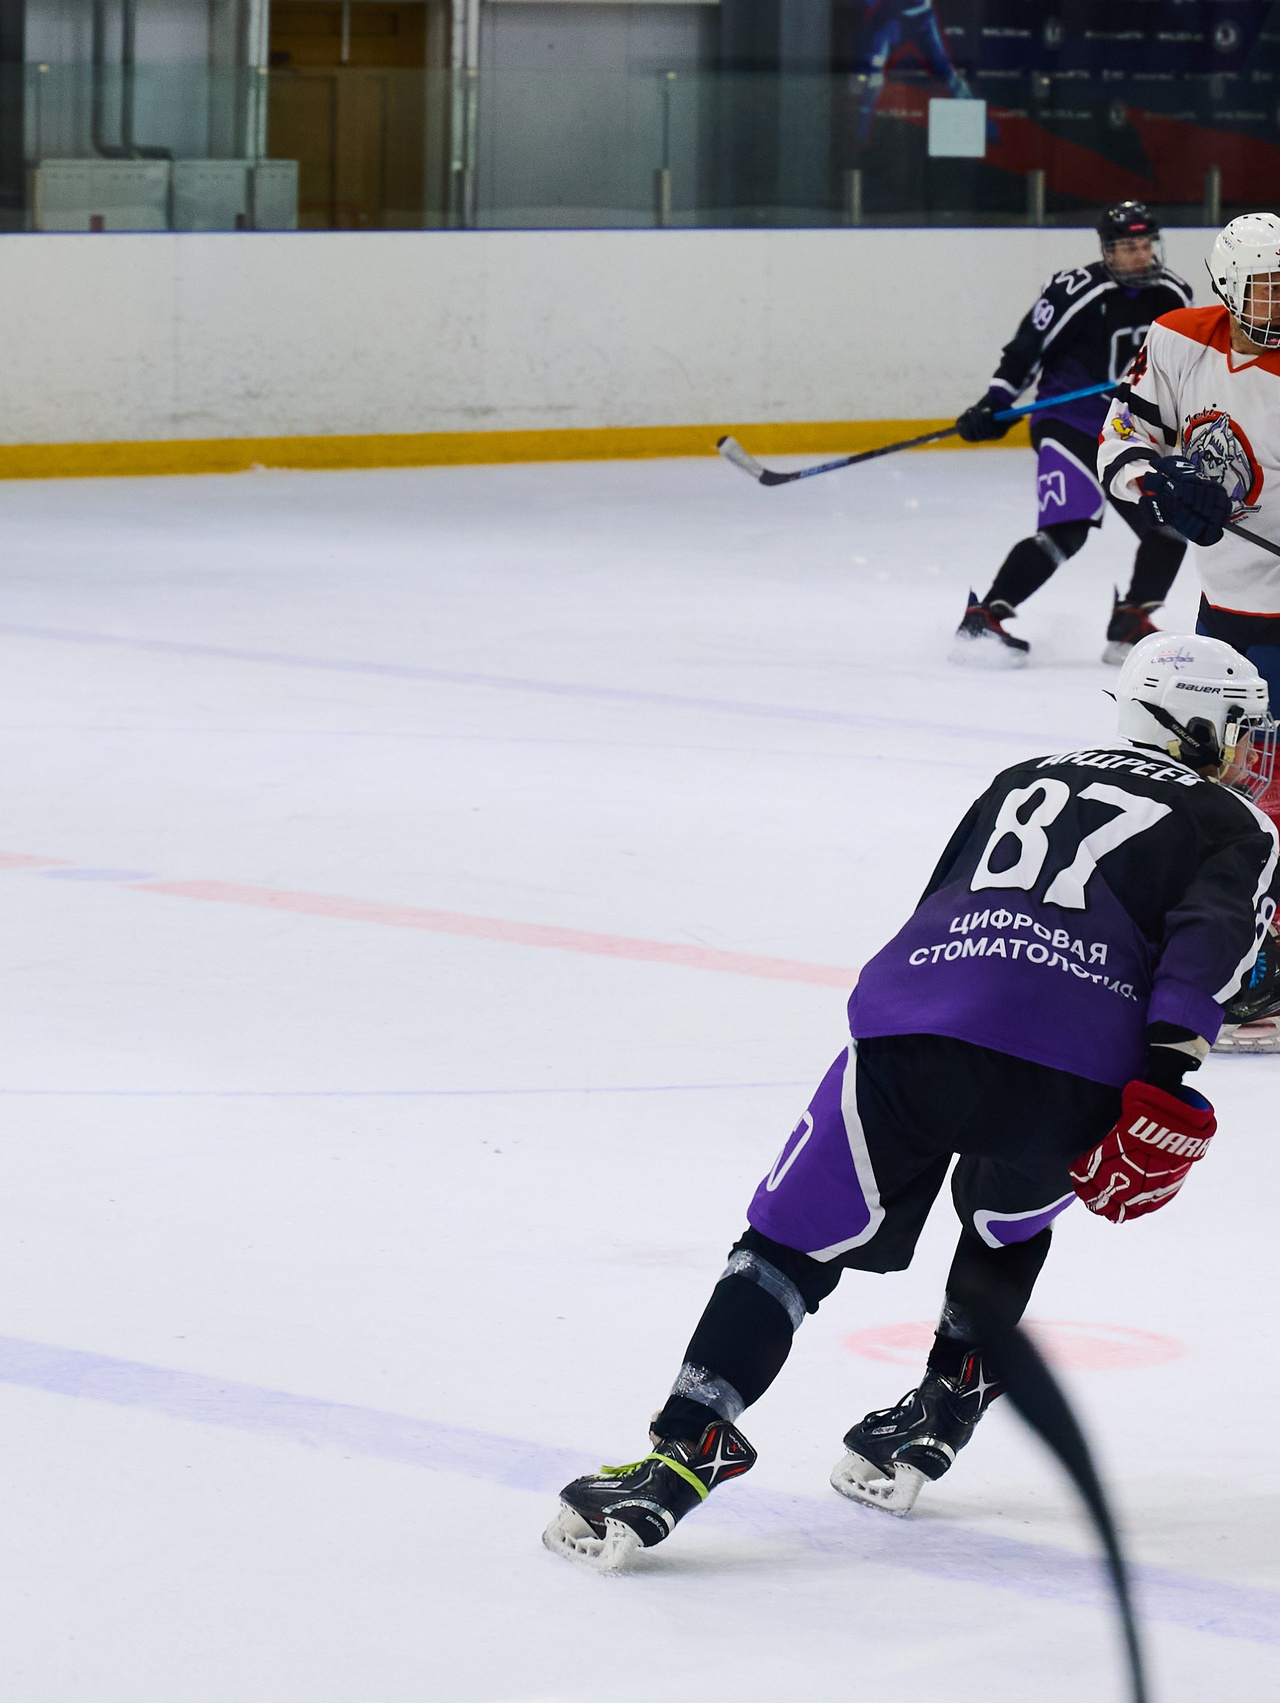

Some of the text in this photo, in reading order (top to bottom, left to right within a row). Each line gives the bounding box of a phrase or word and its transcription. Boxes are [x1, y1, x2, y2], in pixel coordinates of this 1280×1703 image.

[1175, 681, 1222, 695] BAUER
[969, 777, 1173, 910] 87
[949, 908, 1108, 966] ЦИФРОВАЯ
